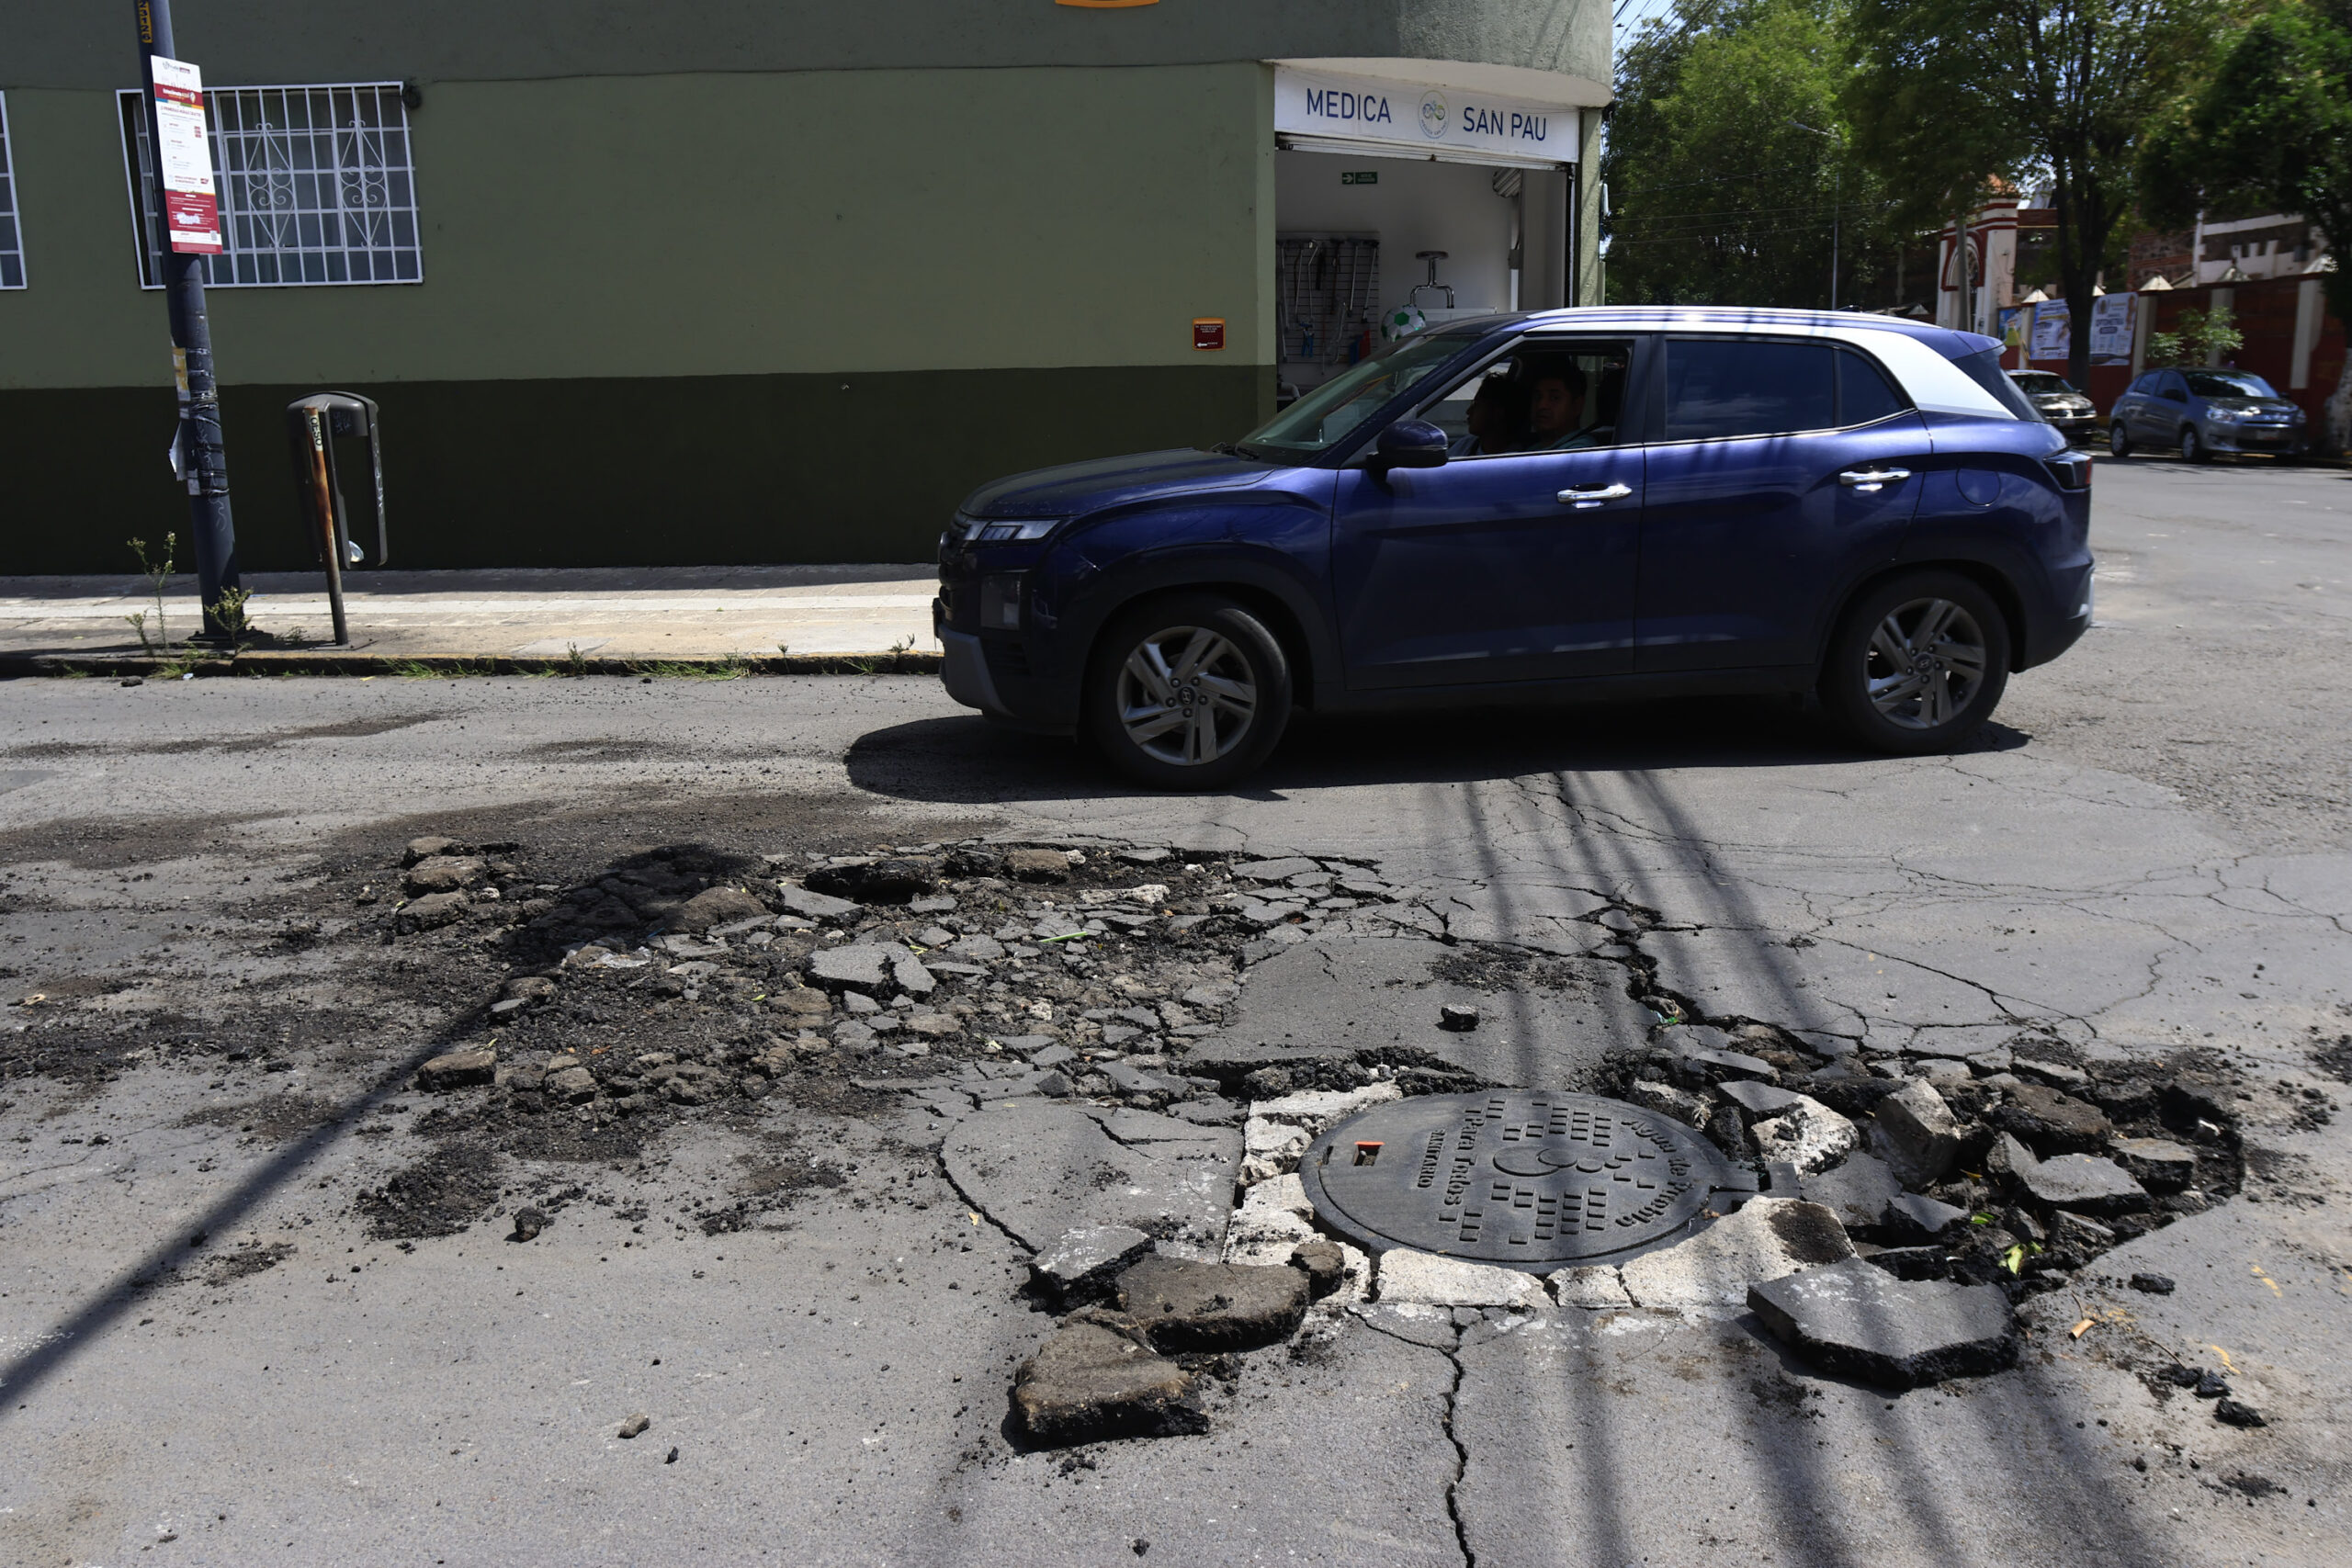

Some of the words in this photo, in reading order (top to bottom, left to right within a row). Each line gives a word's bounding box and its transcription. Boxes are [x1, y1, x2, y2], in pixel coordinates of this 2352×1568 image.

[1306, 87, 1392, 124] MEDICA
[1463, 107, 1504, 136] SAN
[1511, 112, 1546, 141] PAU
[1457, 1118, 1486, 1150] Para
[1620, 1120, 1678, 1153] Agua
[1417, 1128, 1446, 1189] SANITARIO
[1443, 1156, 1477, 1206] Todos
[1668, 1157, 1692, 1177] de
[1615, 1180, 1693, 1227] Puebla
